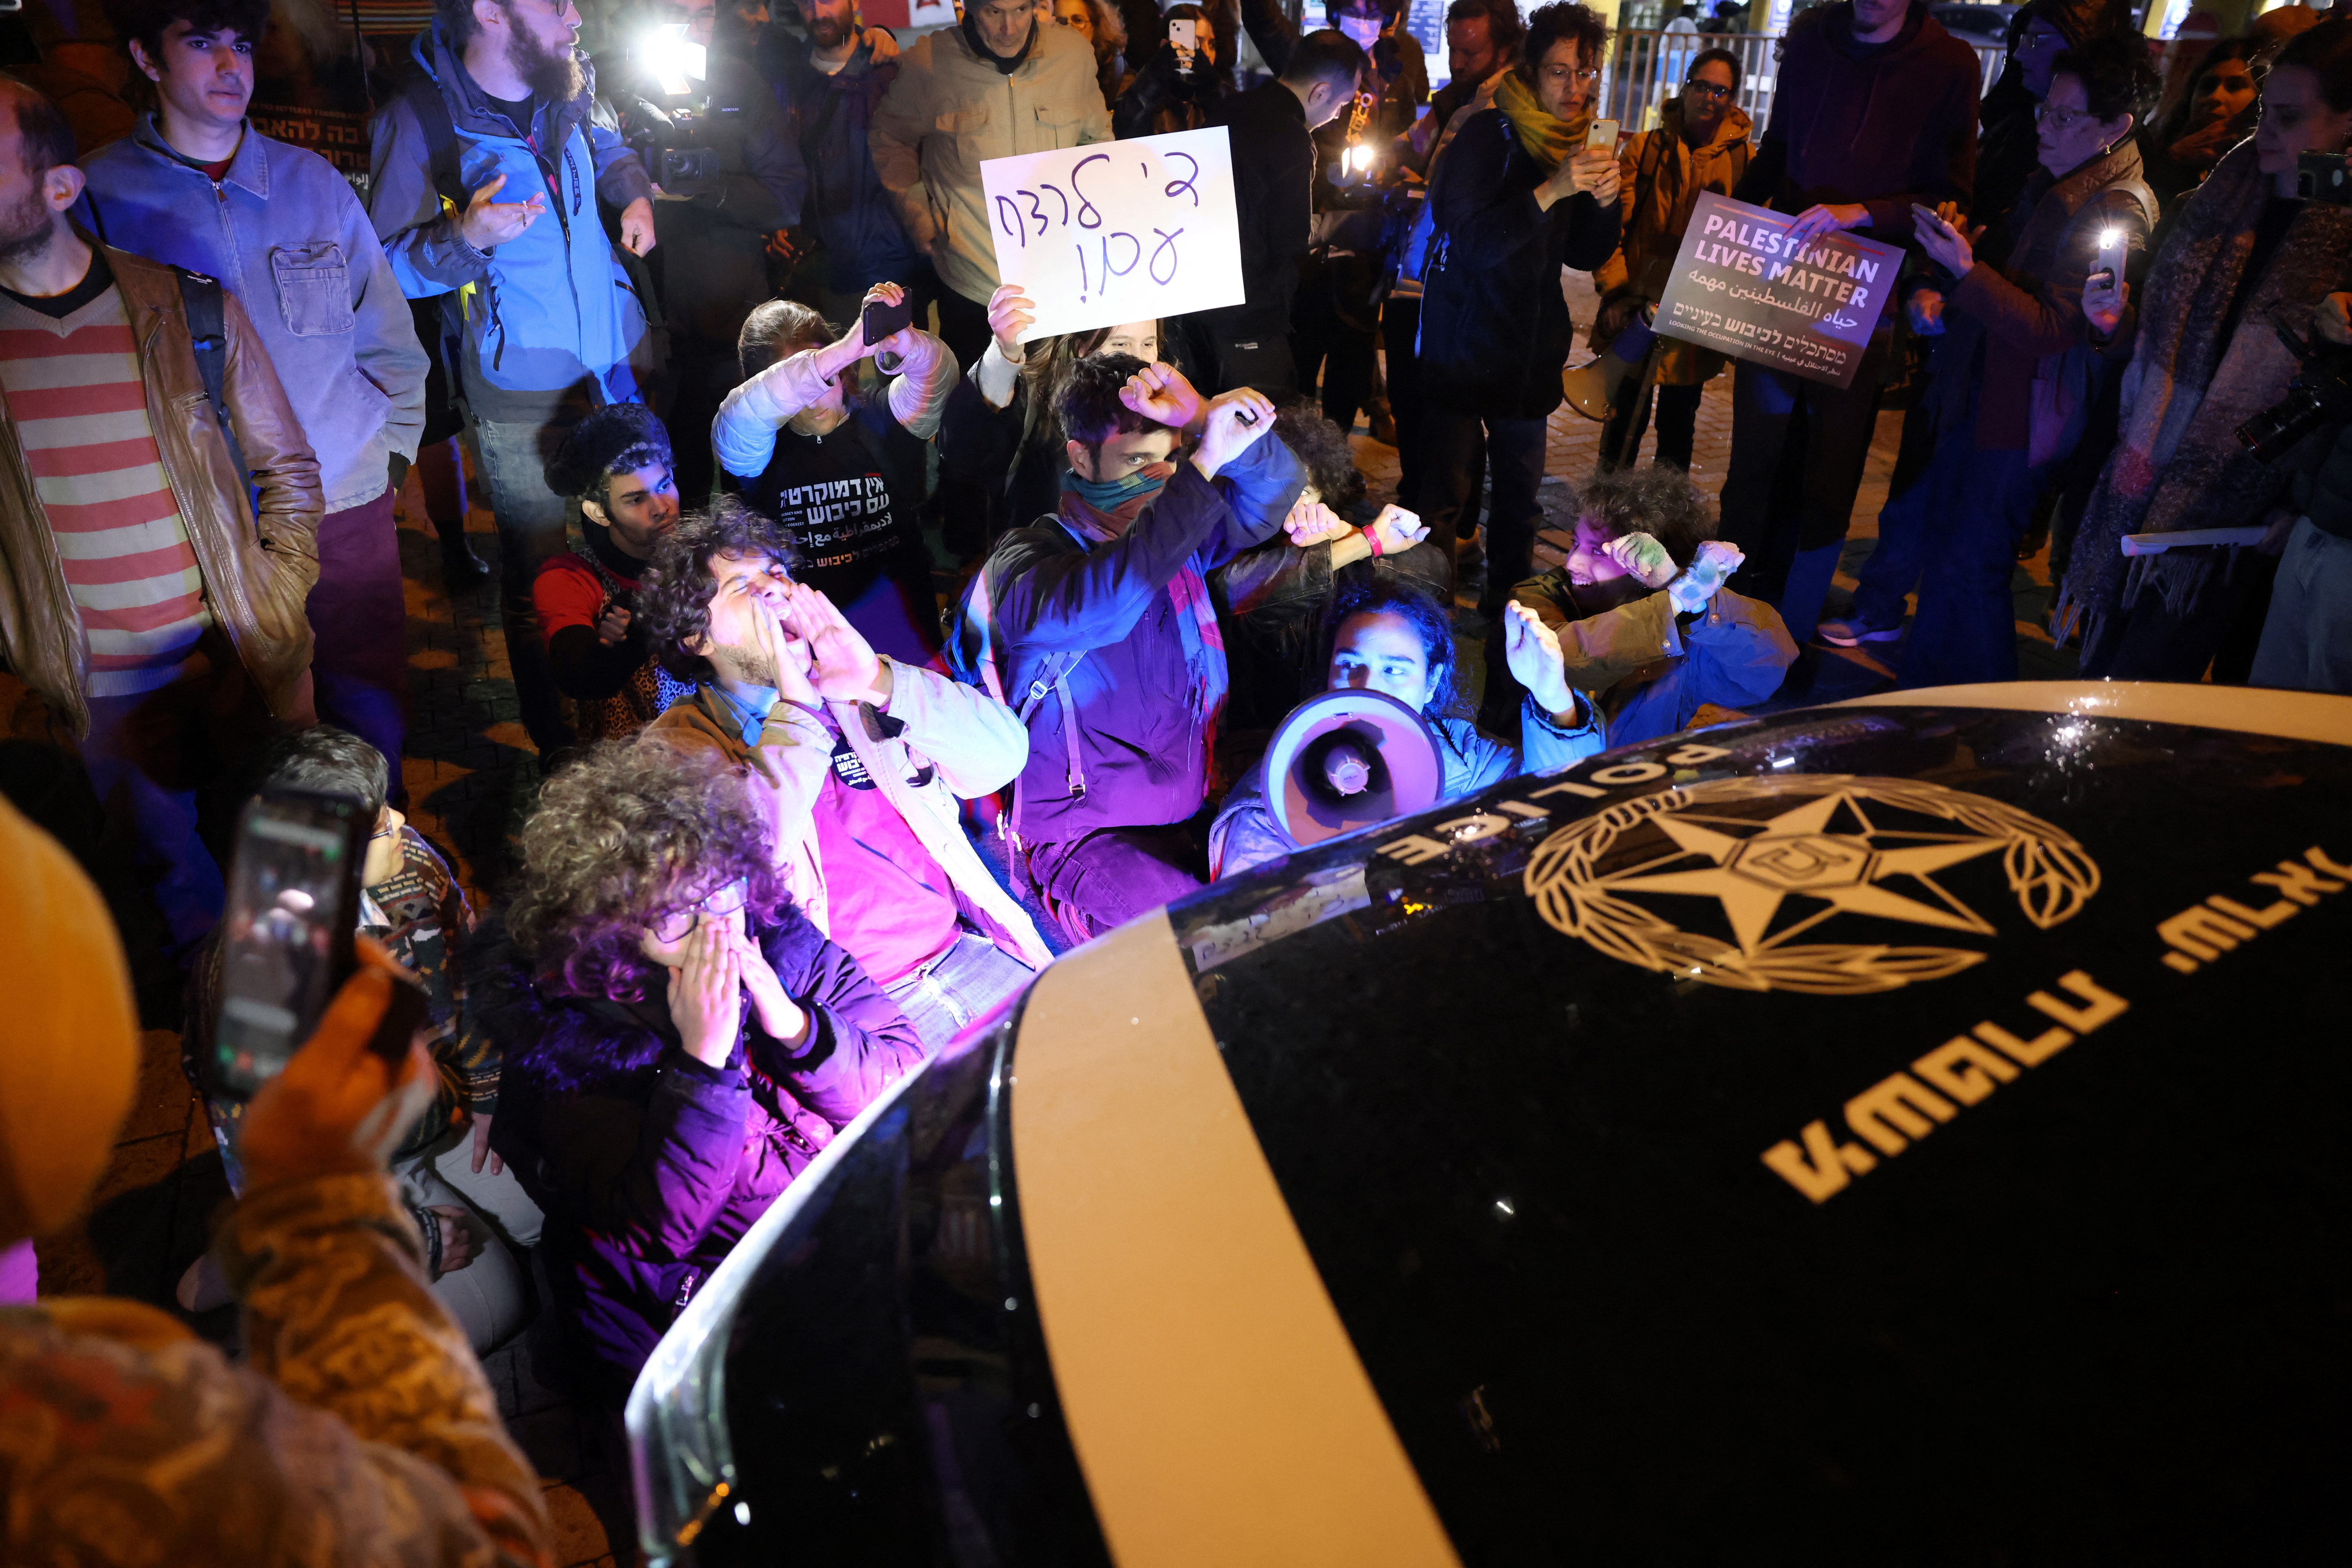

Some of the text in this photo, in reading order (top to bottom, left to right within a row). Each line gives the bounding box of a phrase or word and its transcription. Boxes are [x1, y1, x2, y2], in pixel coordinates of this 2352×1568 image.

[250, 117, 321, 140] להאב
[1704, 214, 1879, 283] PALESTINIAN
[1694, 239, 1869, 308] LIVES MATTER
[1669, 319, 1696, 332] LOOKING
[1696, 327, 1708, 336] THE
[1708, 331, 1744, 346] OCCUPATION
[1672, 302, 1846, 364] מסתכלים לכיבוש בעיניים
[865, 477, 884, 498] אין
[806, 493, 890, 525] עם כיבוש
[814, 533, 832, 547] مع
[816, 550, 860, 567] לכיבוש
[837, 758, 861, 772] יבוש
[1376, 743, 1733, 867] POLICE
[1759, 968, 2132, 1206] משטרת
